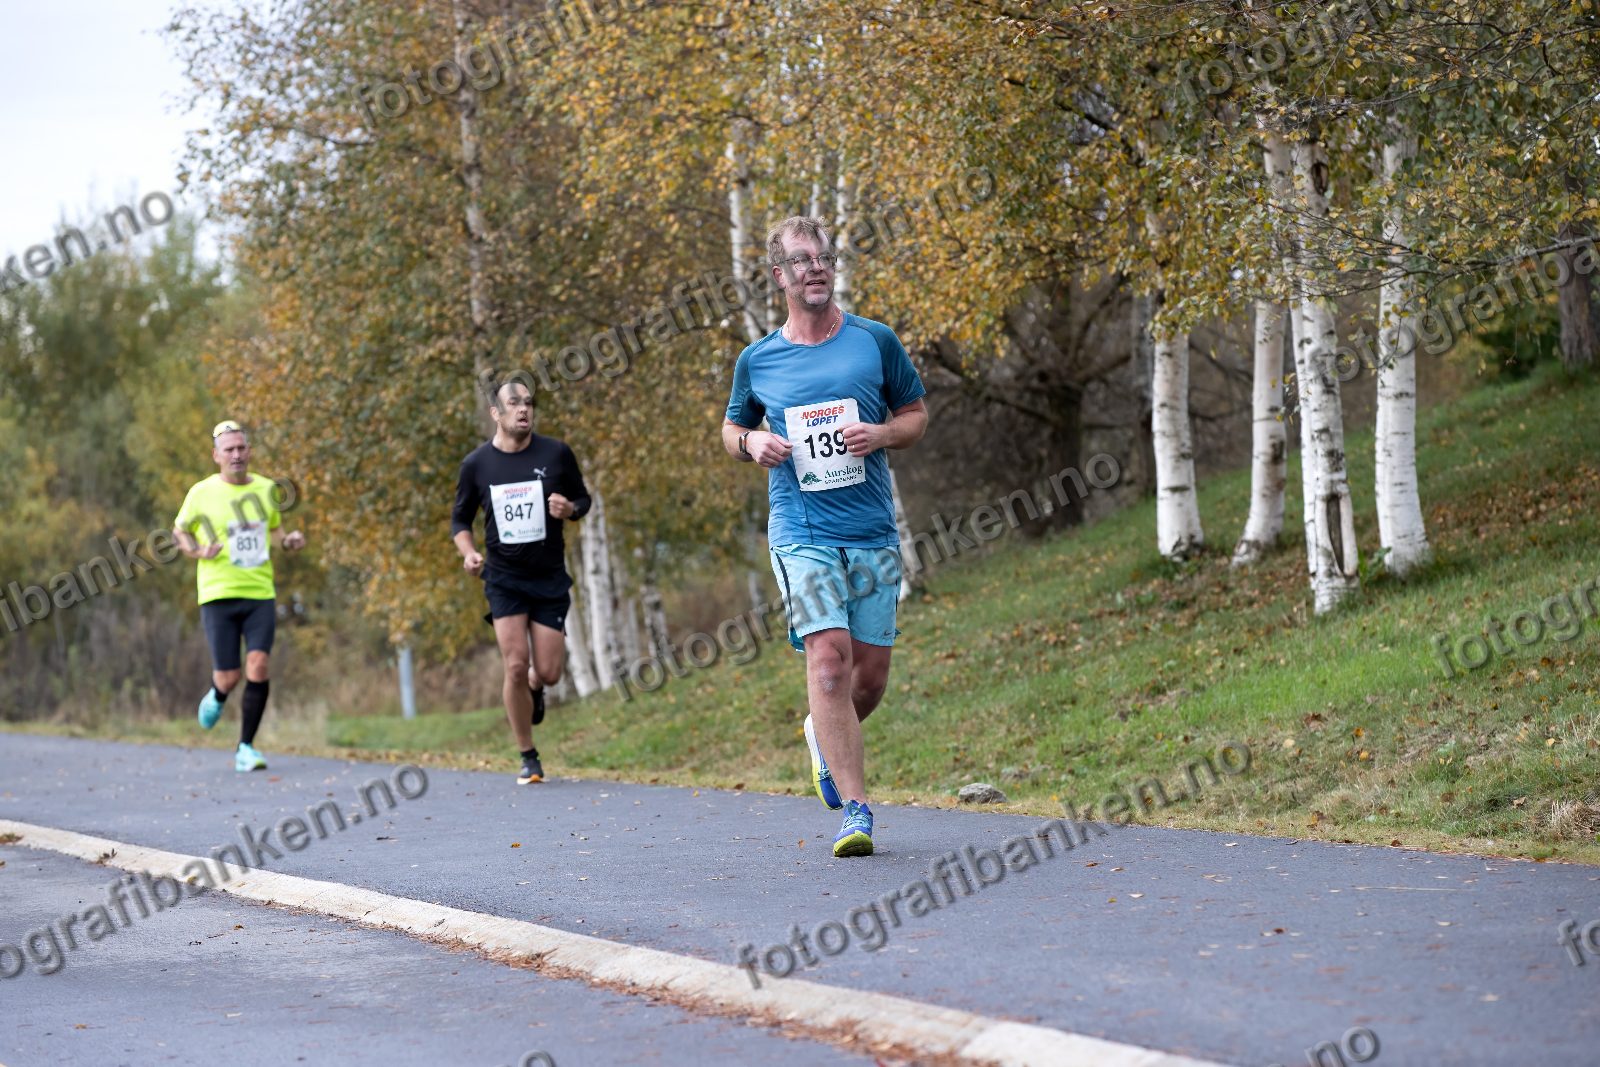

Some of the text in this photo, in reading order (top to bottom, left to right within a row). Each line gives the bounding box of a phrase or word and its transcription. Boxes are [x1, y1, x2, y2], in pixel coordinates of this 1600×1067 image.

[802, 406, 845, 420] NORGES
[806, 415, 838, 427] LØPET
[804, 430, 847, 459] 139
[824, 465, 863, 479] Aurskog
[504, 502, 534, 522] 847
[237, 536, 258, 551] 831
